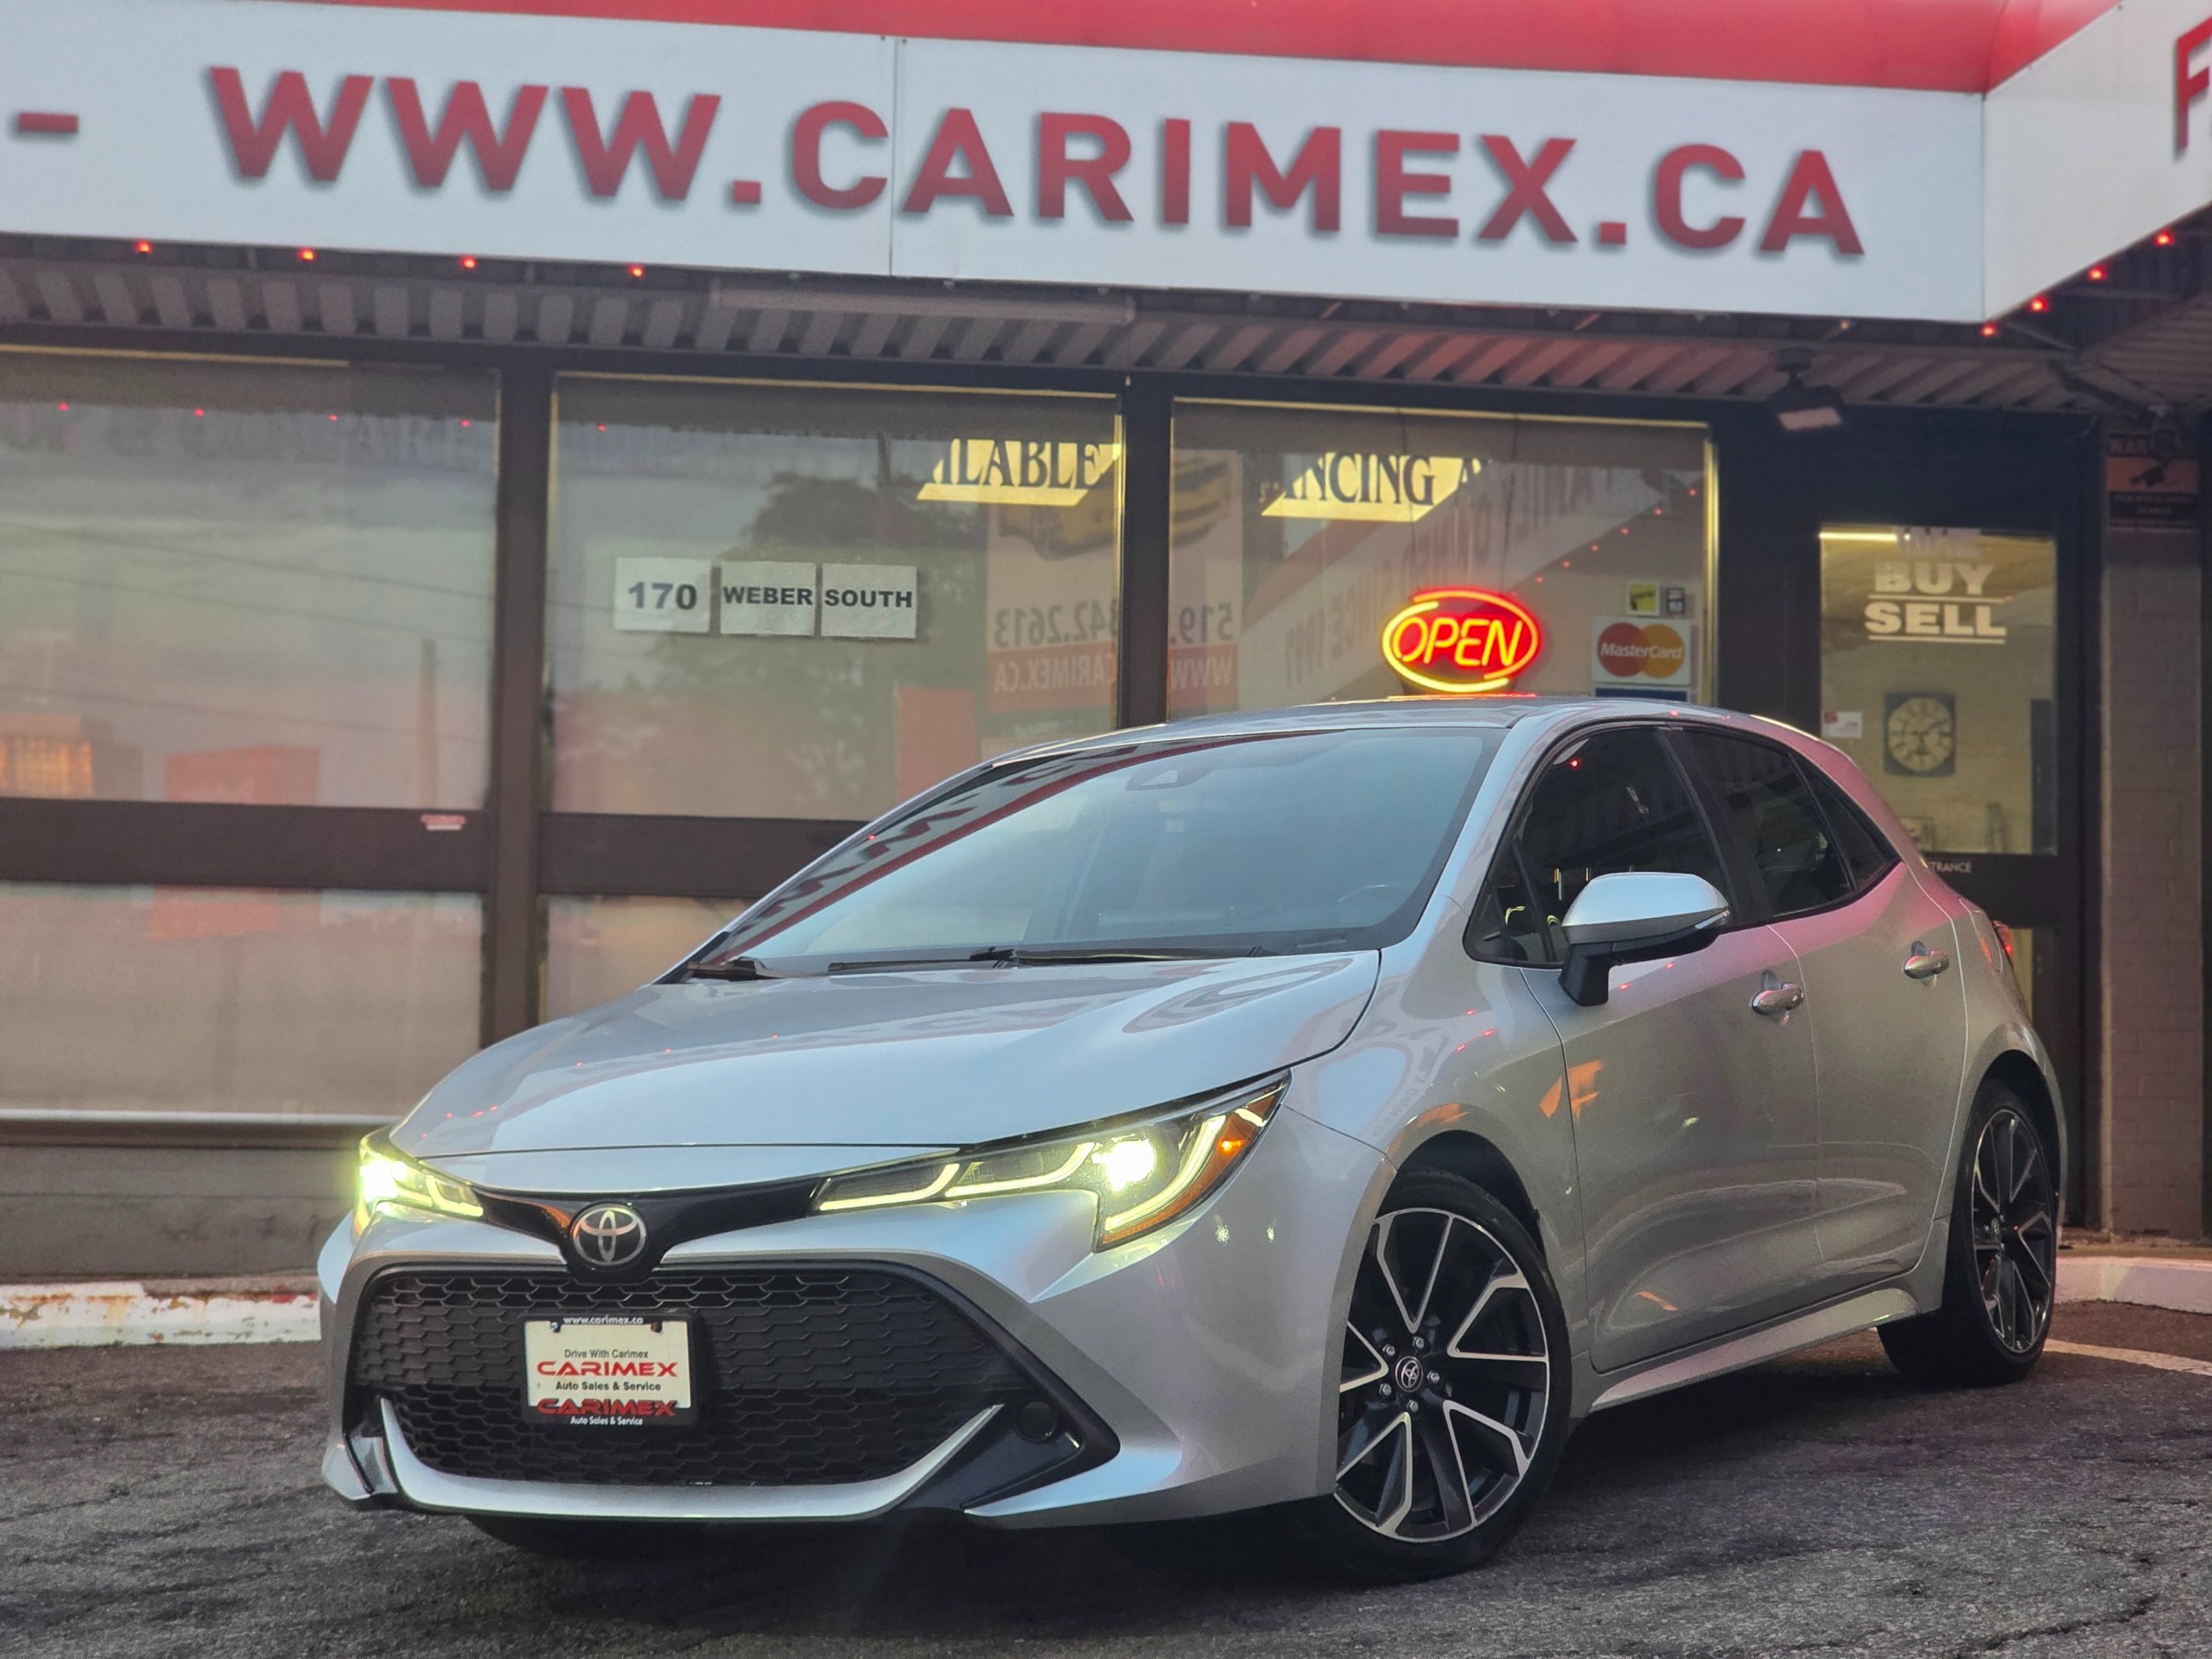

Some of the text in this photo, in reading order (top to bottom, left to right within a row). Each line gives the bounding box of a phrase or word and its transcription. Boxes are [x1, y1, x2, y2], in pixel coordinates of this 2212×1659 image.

[208, 65, 1865, 257] WWW.CARIMEX.CA
[1874, 560, 1994, 594] BUY
[628, 581, 698, 610] 170
[723, 586, 814, 606] WEBER
[824, 588, 912, 608] SOUTH
[1864, 601, 2007, 637] SELL
[1392, 617, 1524, 666] OPEN
[1600, 642, 1682, 659] MasterCard
[563, 1313, 644, 1324] www.carimex.ca
[564, 1348, 649, 1359] Drive With Carimex
[536, 1361, 678, 1377] CARIMEX
[555, 1382, 662, 1392] Auto Sales & Service
[536, 1397, 678, 1417] CARIMEX
[570, 1416, 643, 1426] Auto Sales & Service
